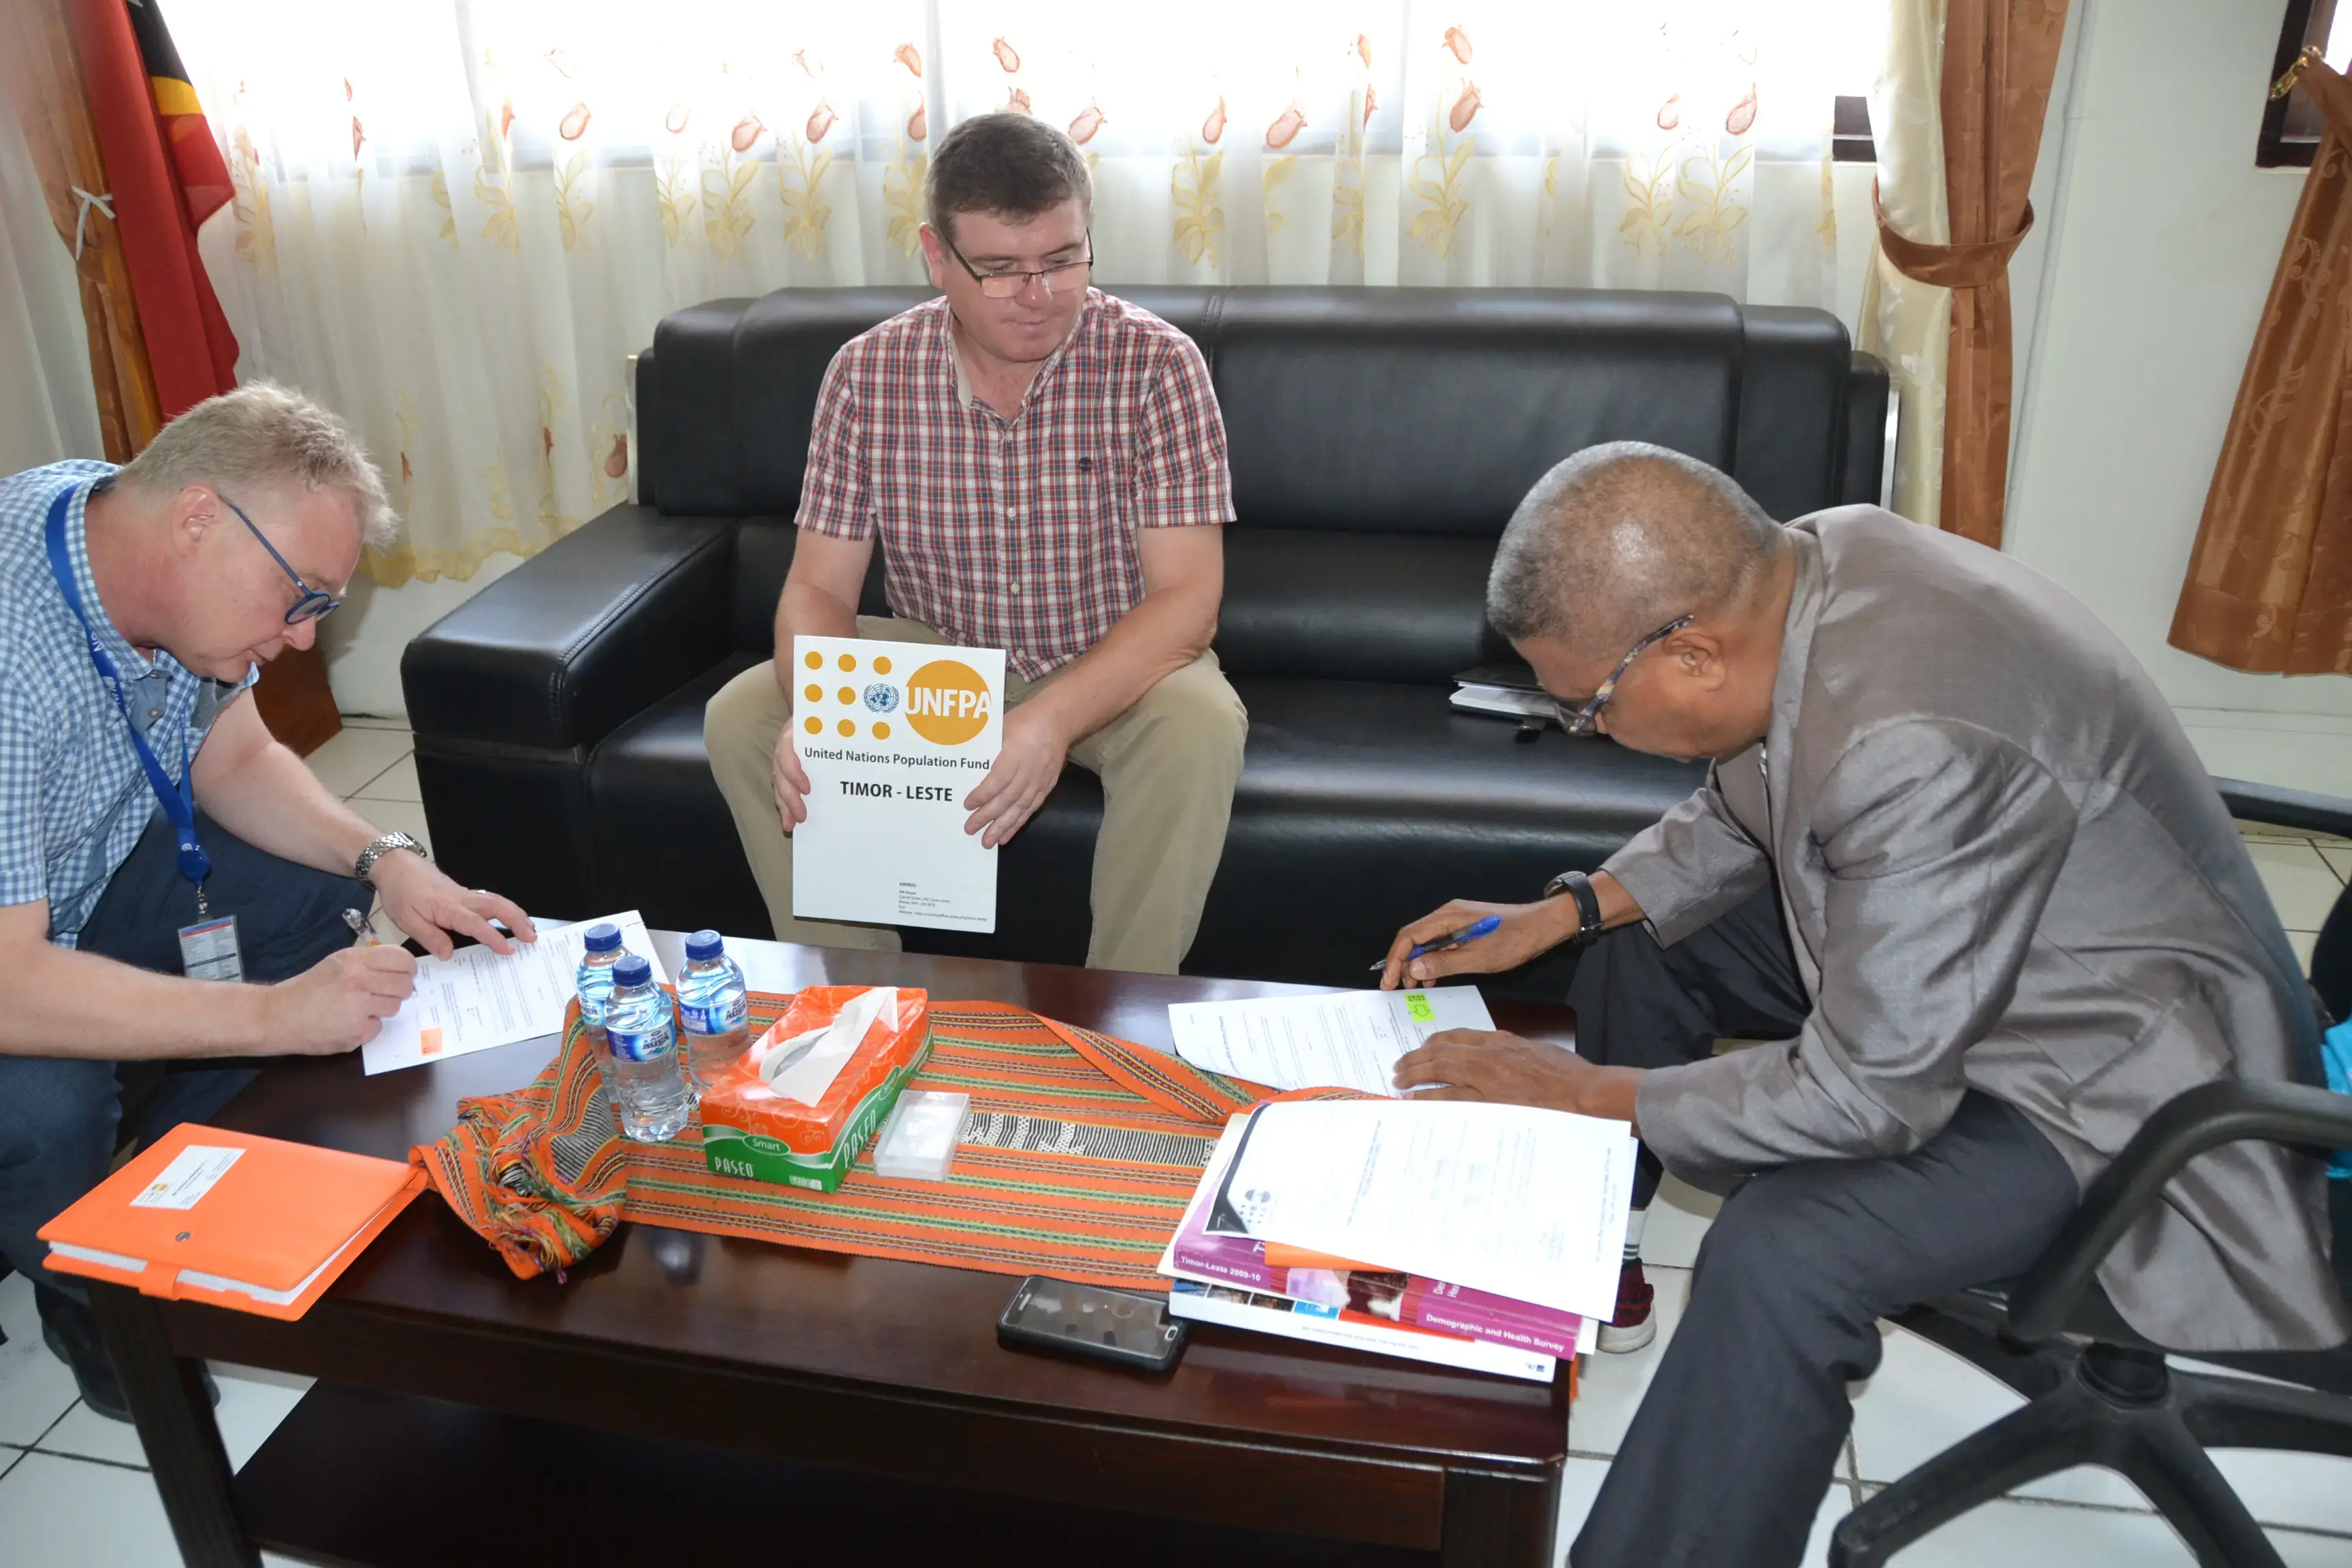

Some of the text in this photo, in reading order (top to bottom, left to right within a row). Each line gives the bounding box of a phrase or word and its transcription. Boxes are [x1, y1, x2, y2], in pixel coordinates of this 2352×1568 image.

[904, 686, 992, 719] UNFPA
[804, 747, 990, 770] United Nations Population Fund
[840, 781, 892, 798] TIMOR
[906, 785, 953, 802] LESTE
[752, 1138, 781, 1152] Smart
[843, 1109, 877, 1169] PASEO
[715, 1156, 753, 1177] PASEO
[1181, 1256, 1261, 1282] Timor-Leste 2009-10
[1426, 1313, 1565, 1353] Demographic and Health Survey
